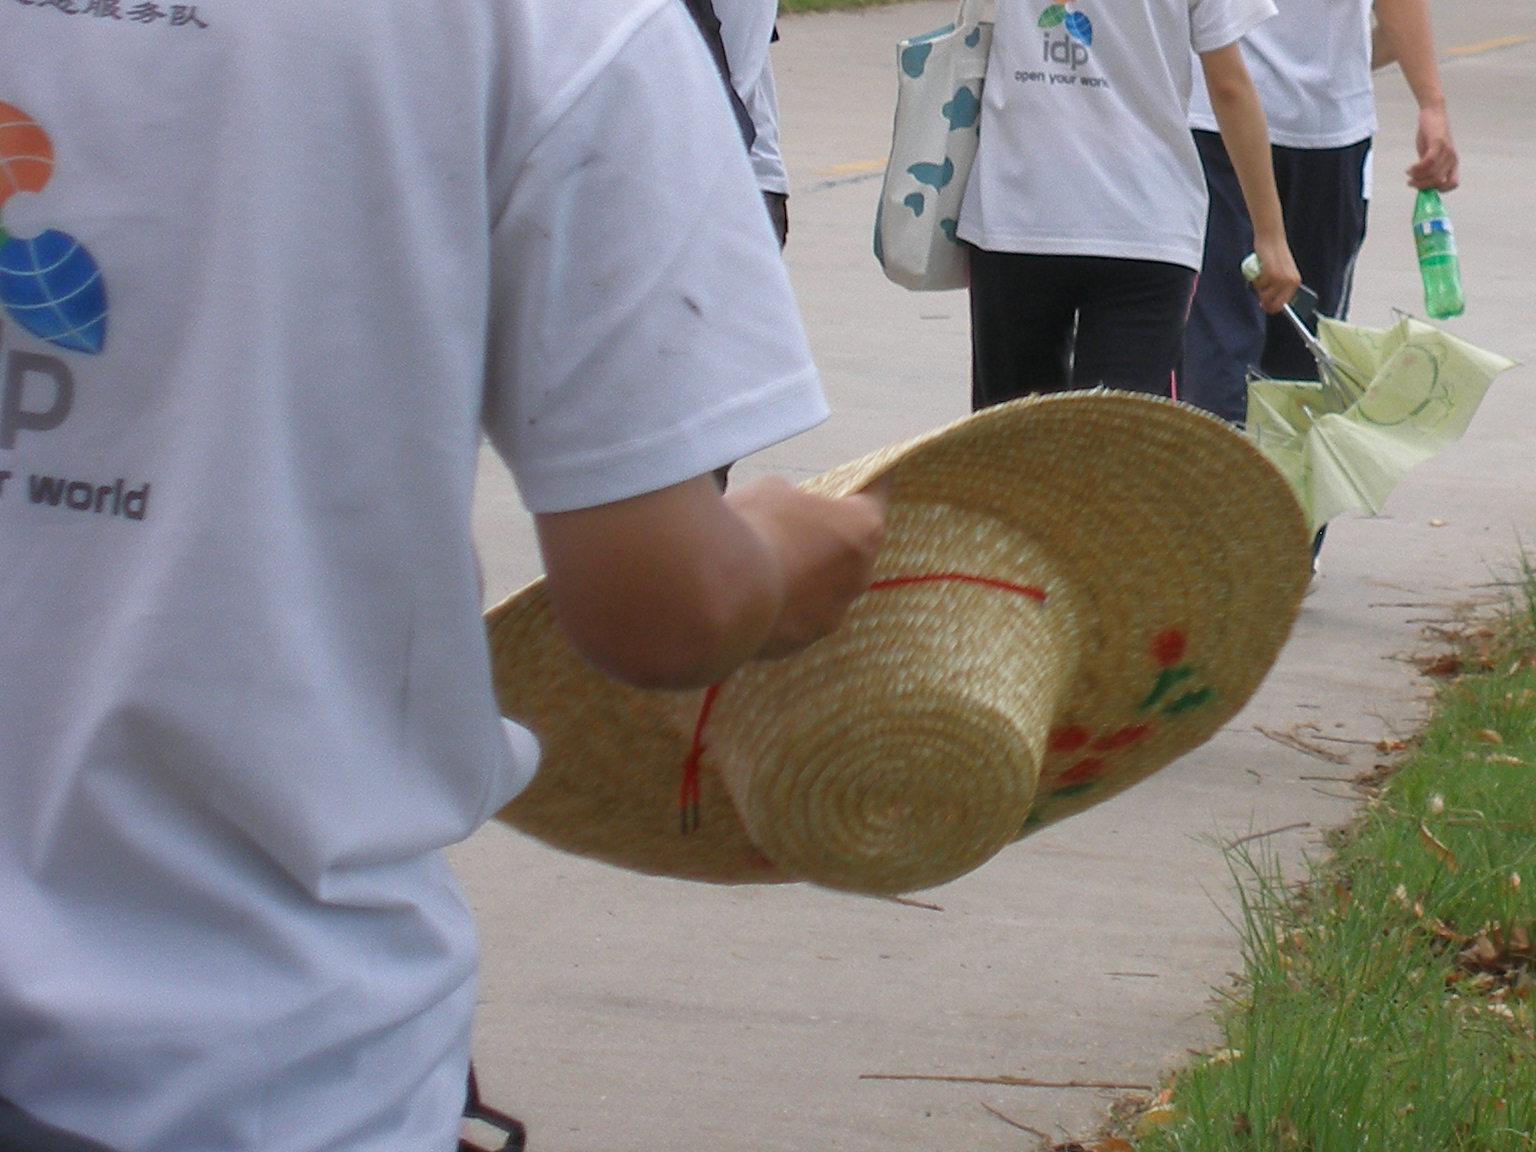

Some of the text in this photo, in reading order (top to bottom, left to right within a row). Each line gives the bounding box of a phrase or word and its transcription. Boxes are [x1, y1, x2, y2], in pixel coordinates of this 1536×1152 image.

[1043, 31, 1089, 70] idp
[1014, 70, 1045, 83] open
[1048, 73, 1077, 84] your
[28, 473, 151, 520] world
